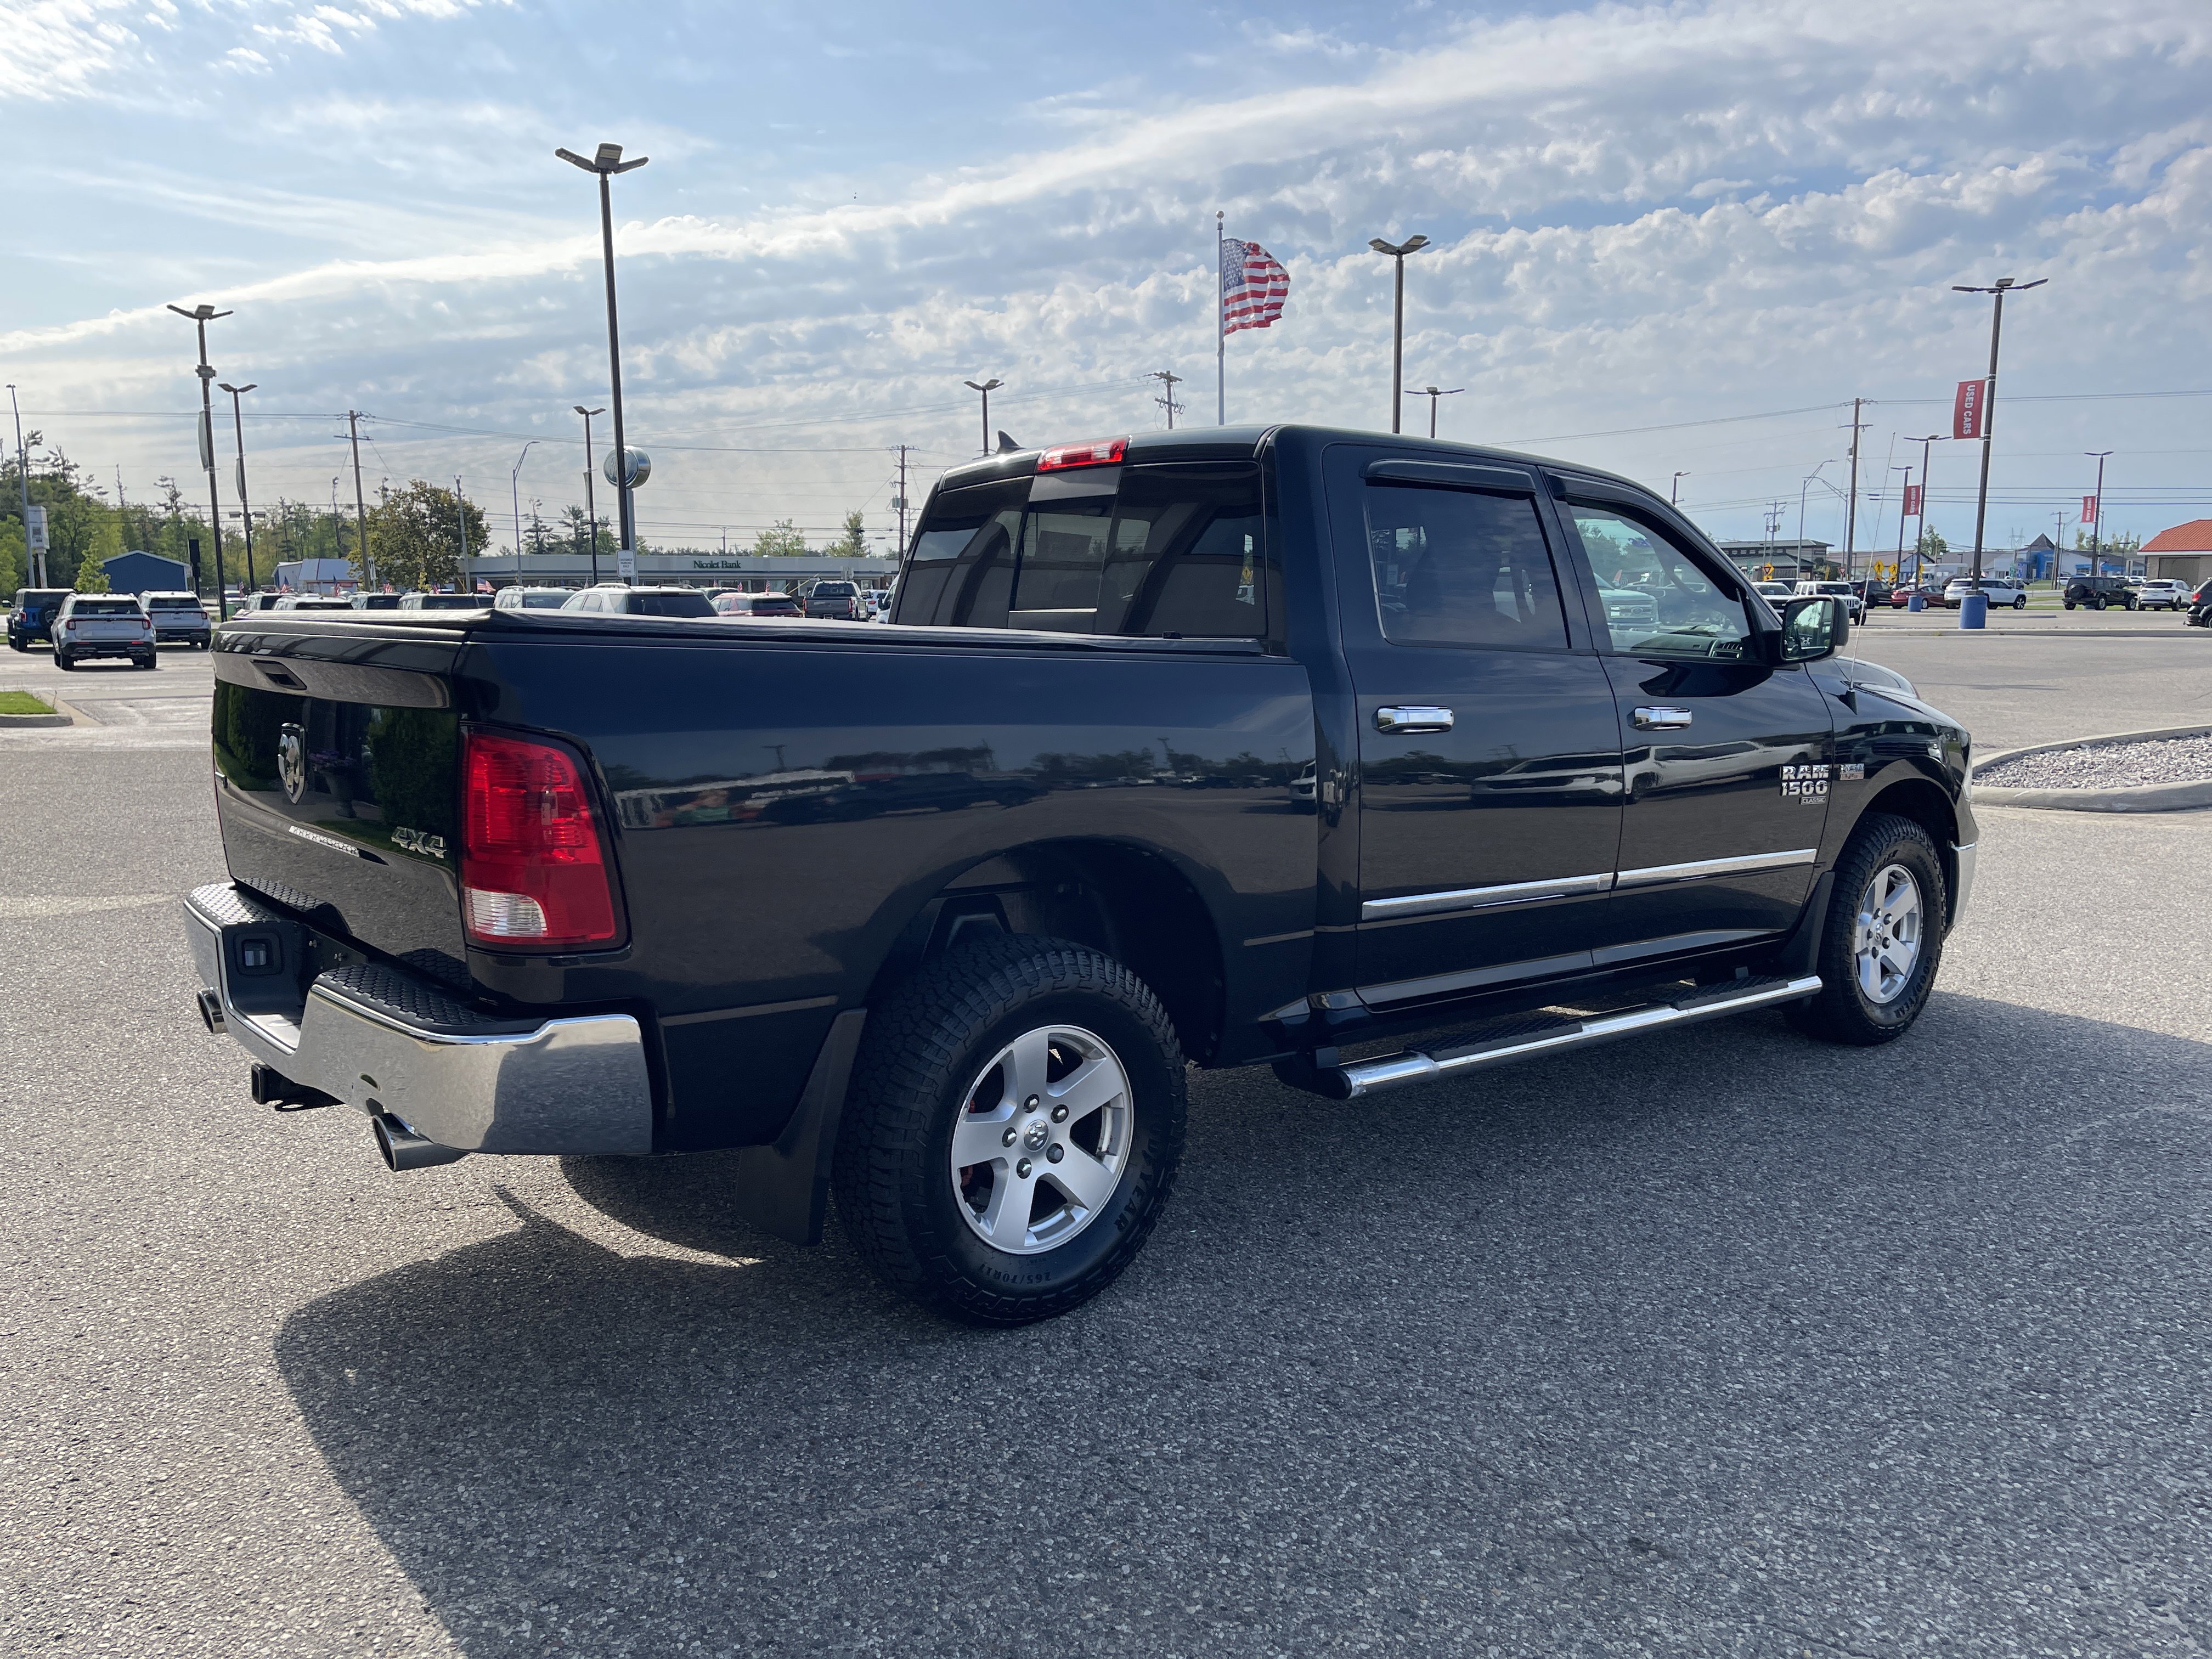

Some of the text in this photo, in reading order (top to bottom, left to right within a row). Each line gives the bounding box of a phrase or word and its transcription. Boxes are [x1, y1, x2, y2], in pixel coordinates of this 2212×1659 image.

[1962, 385, 1975, 435] USED CARS
[693, 560, 742, 568] Nicolet Bank
[1781, 764, 1829, 780] RAM
[1781, 780, 1828, 797] 1500
[978, 1262, 1052, 1285] 265/70R17
